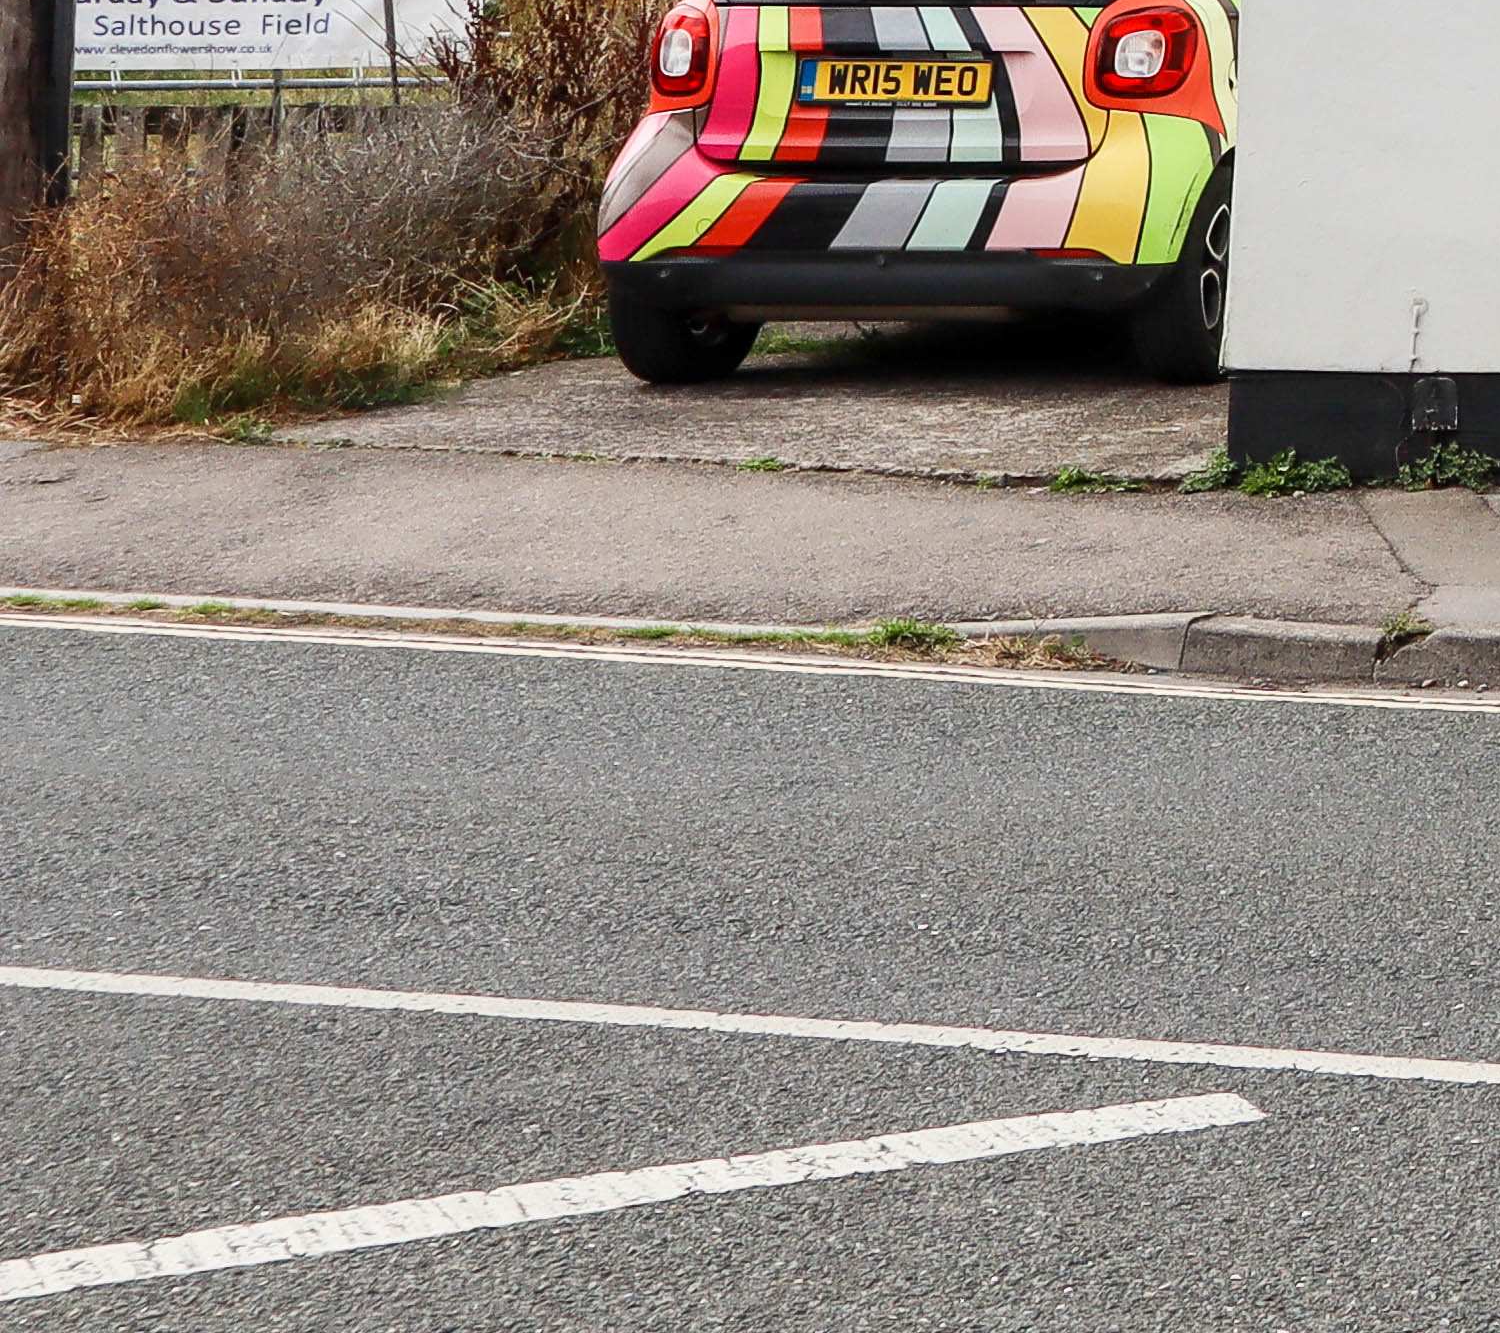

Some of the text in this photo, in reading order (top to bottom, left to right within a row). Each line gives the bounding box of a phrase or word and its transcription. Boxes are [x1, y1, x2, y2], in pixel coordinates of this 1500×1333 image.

[93, 12, 330, 37] Salthouse Field
[828, 63, 979, 97] WR15 WEO
